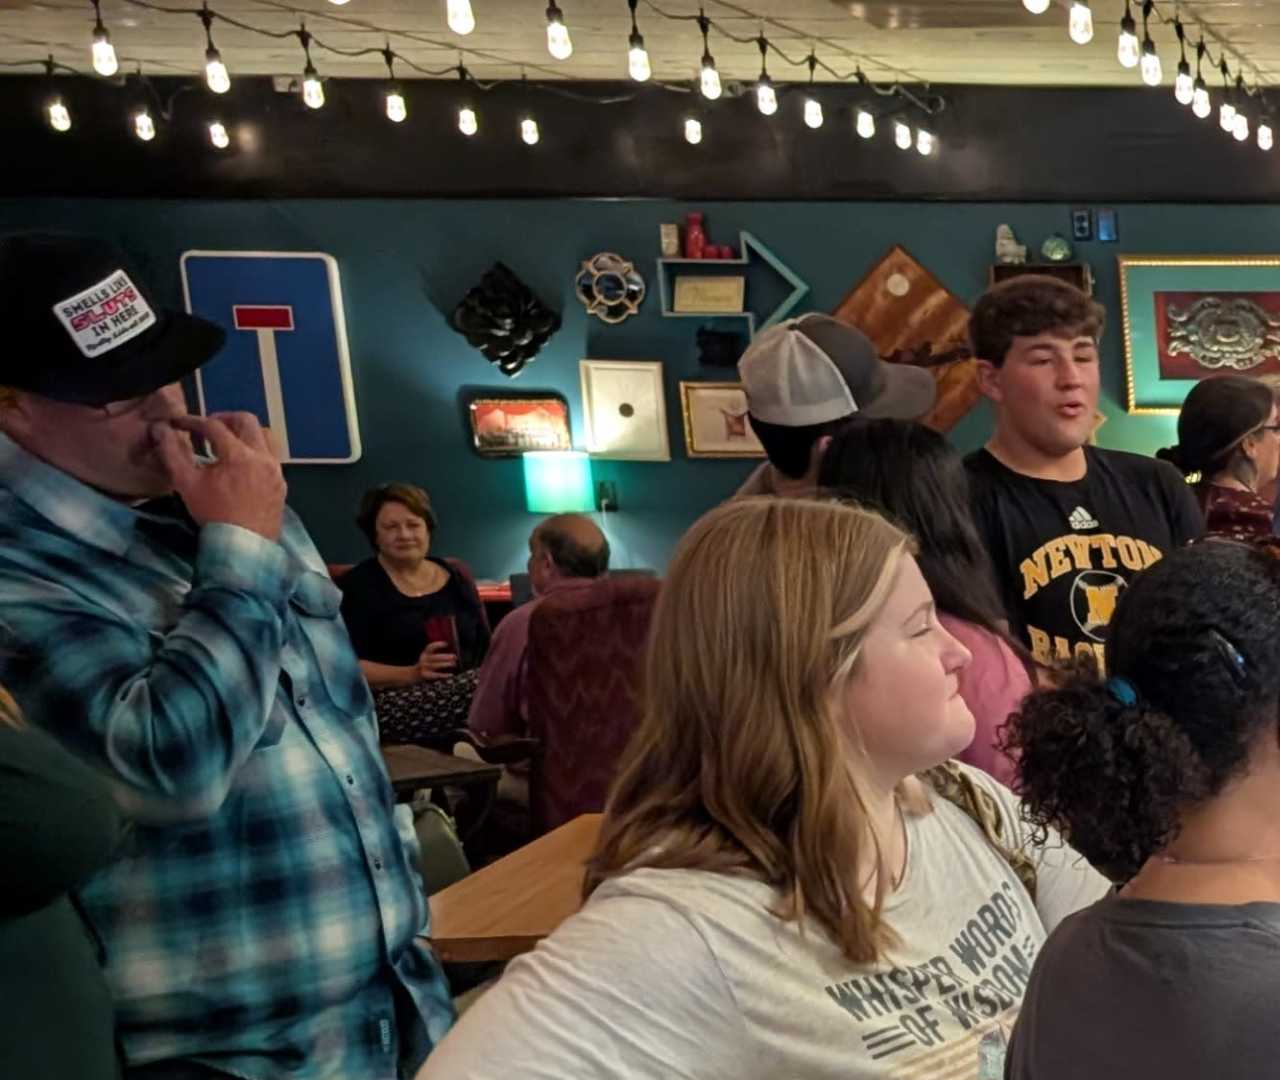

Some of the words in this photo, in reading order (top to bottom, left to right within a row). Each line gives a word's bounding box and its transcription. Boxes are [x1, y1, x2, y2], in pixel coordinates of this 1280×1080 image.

[70, 285, 138, 332] SLUTS
[91, 325, 111, 337] IN
[1019, 533, 1164, 600] NEWTON
[825, 955, 969, 1022] WHISPER
[899, 1003, 945, 1048] OF
